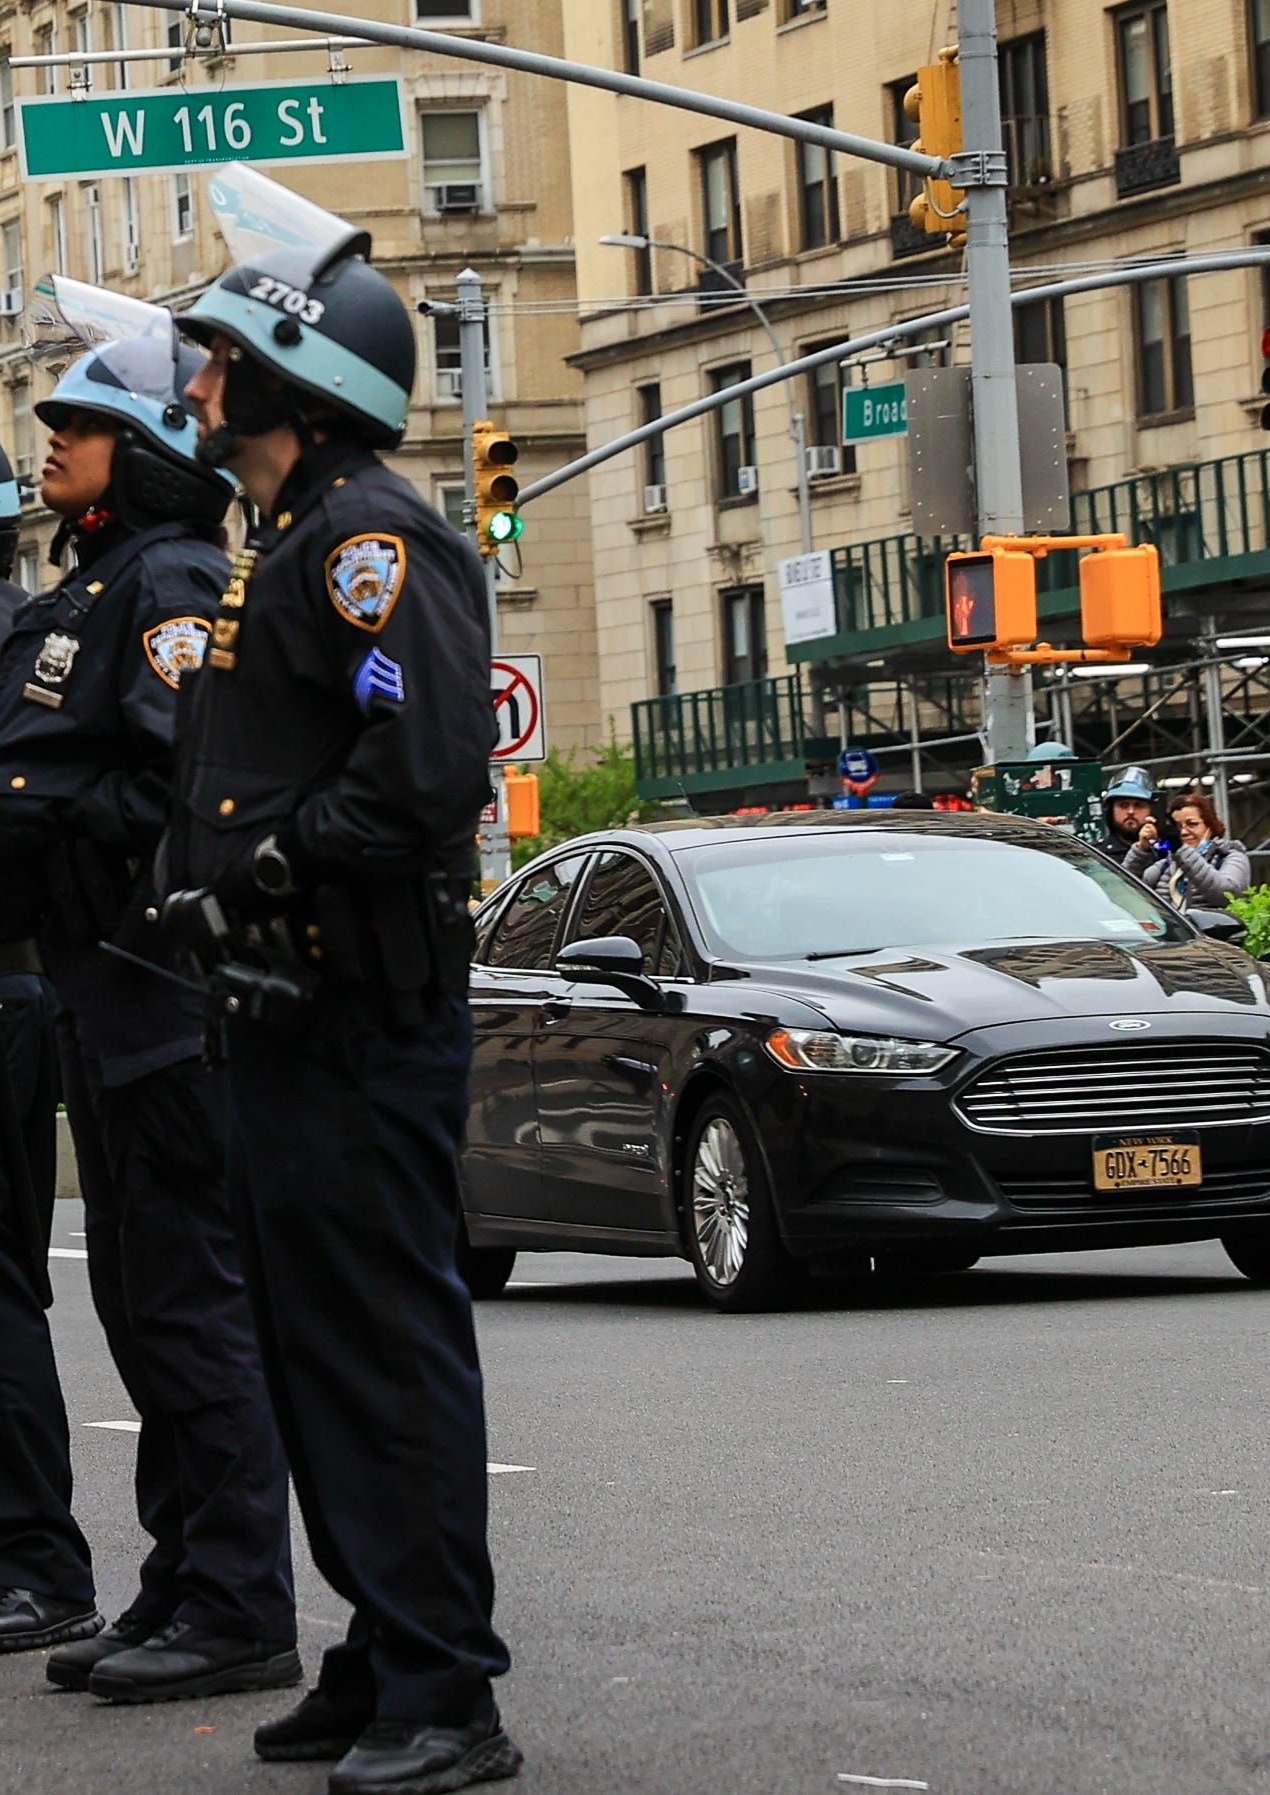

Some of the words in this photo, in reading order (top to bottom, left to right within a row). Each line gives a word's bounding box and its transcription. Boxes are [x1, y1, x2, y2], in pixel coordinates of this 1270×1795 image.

[101, 109, 145, 158] W
[173, 102, 251, 152] 116
[277, 97, 327, 146] St
[249, 276, 325, 325] 2703
[1119, 1137, 1145, 1147] NEW
[1147, 1135, 1174, 1145] YORK
